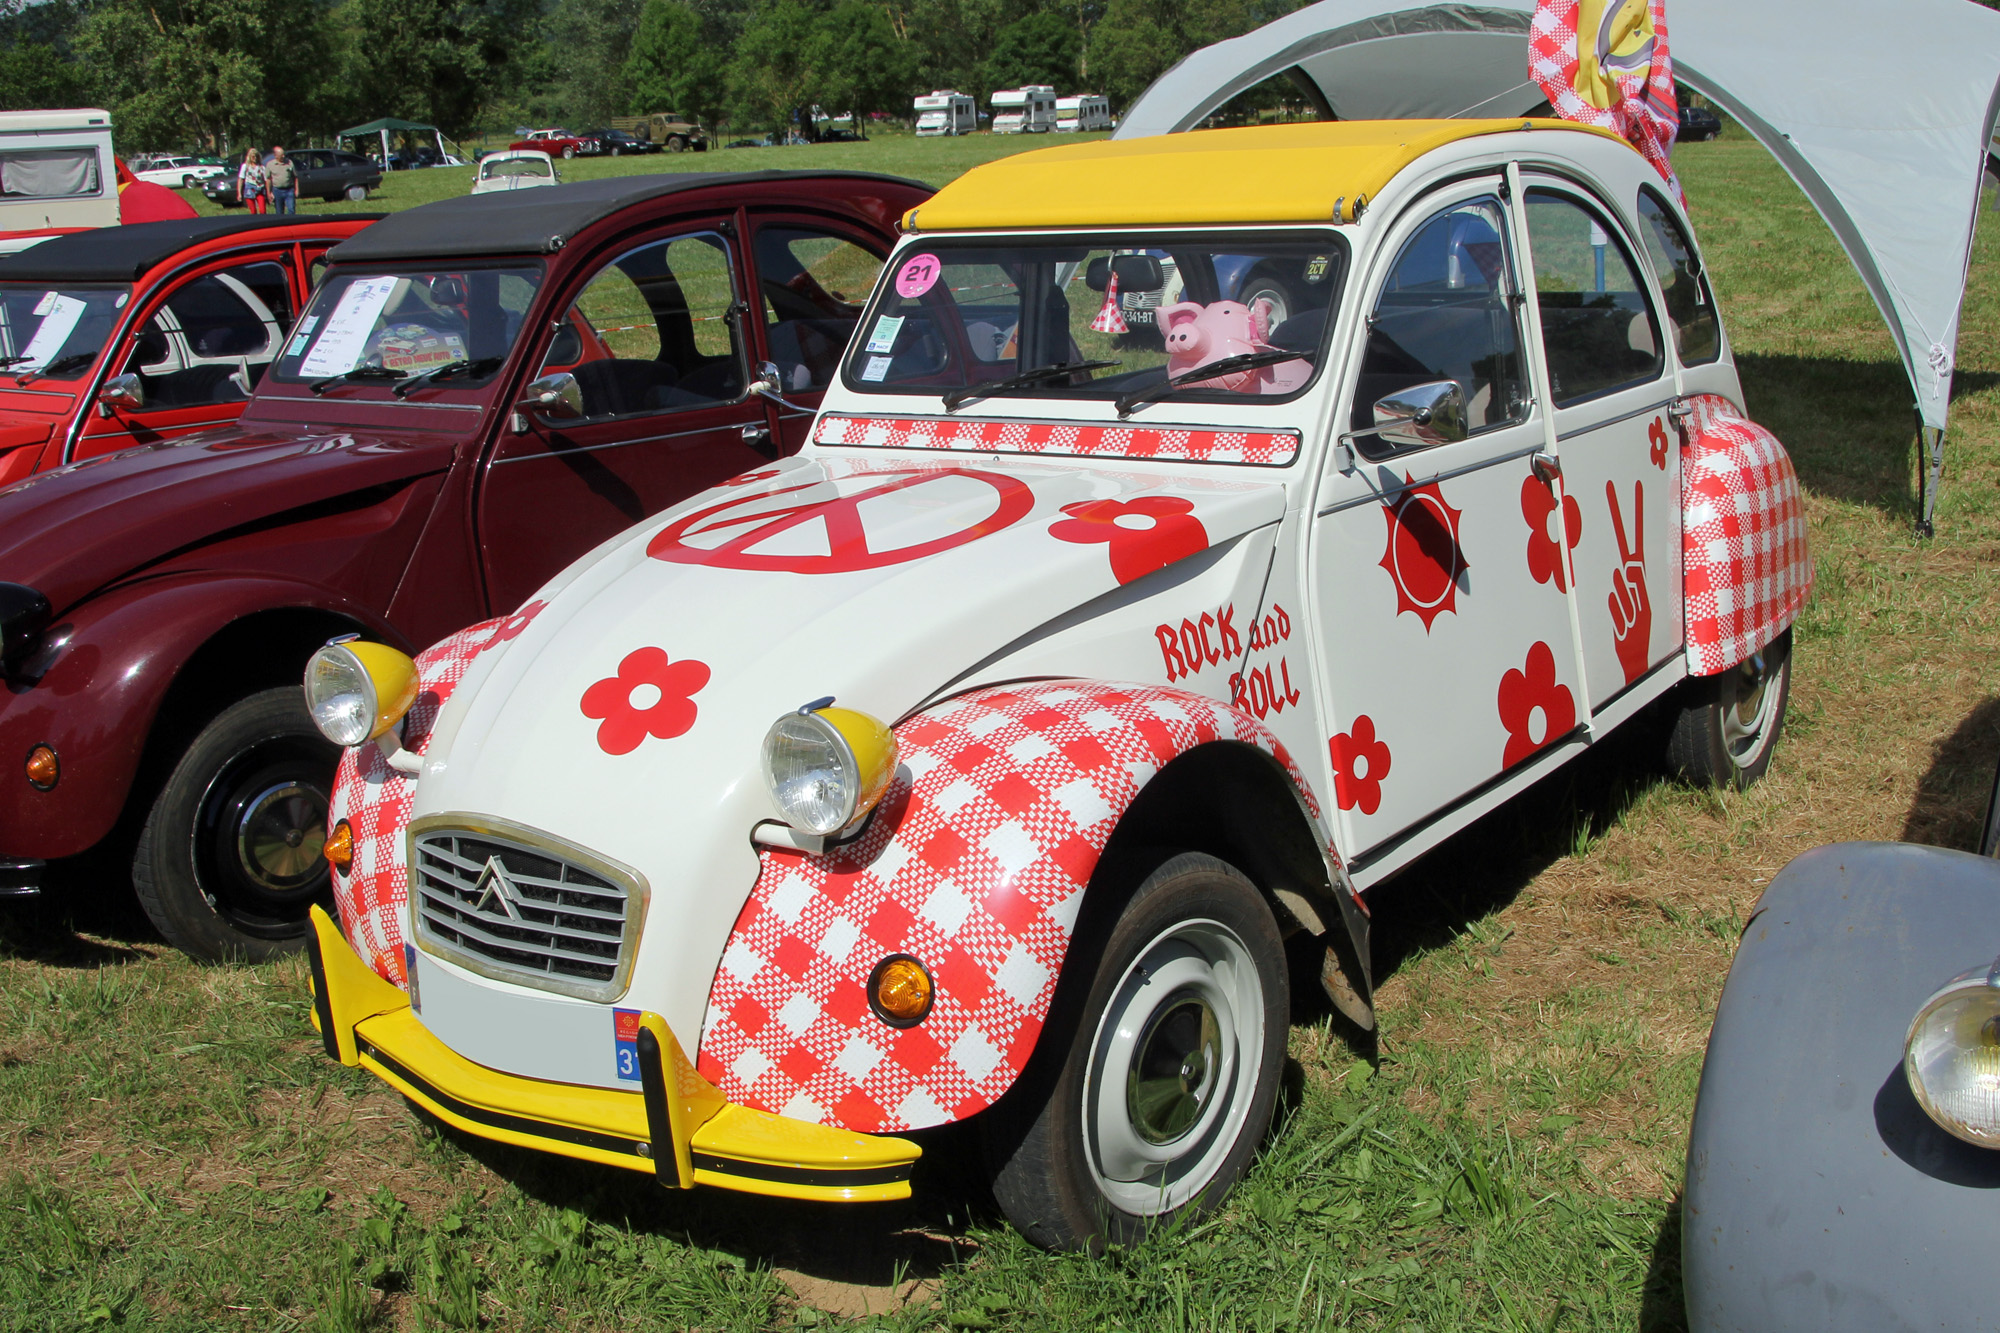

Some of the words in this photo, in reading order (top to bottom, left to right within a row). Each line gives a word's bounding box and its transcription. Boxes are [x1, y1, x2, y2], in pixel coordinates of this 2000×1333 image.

[905, 264, 932, 281] 21
[1307, 263, 1327, 274] 2CV
[1154, 602, 1243, 684] ROCK
[1249, 603, 1291, 652] and
[1228, 655, 1300, 721] ROLL
[619, 1048, 638, 1075] 3
